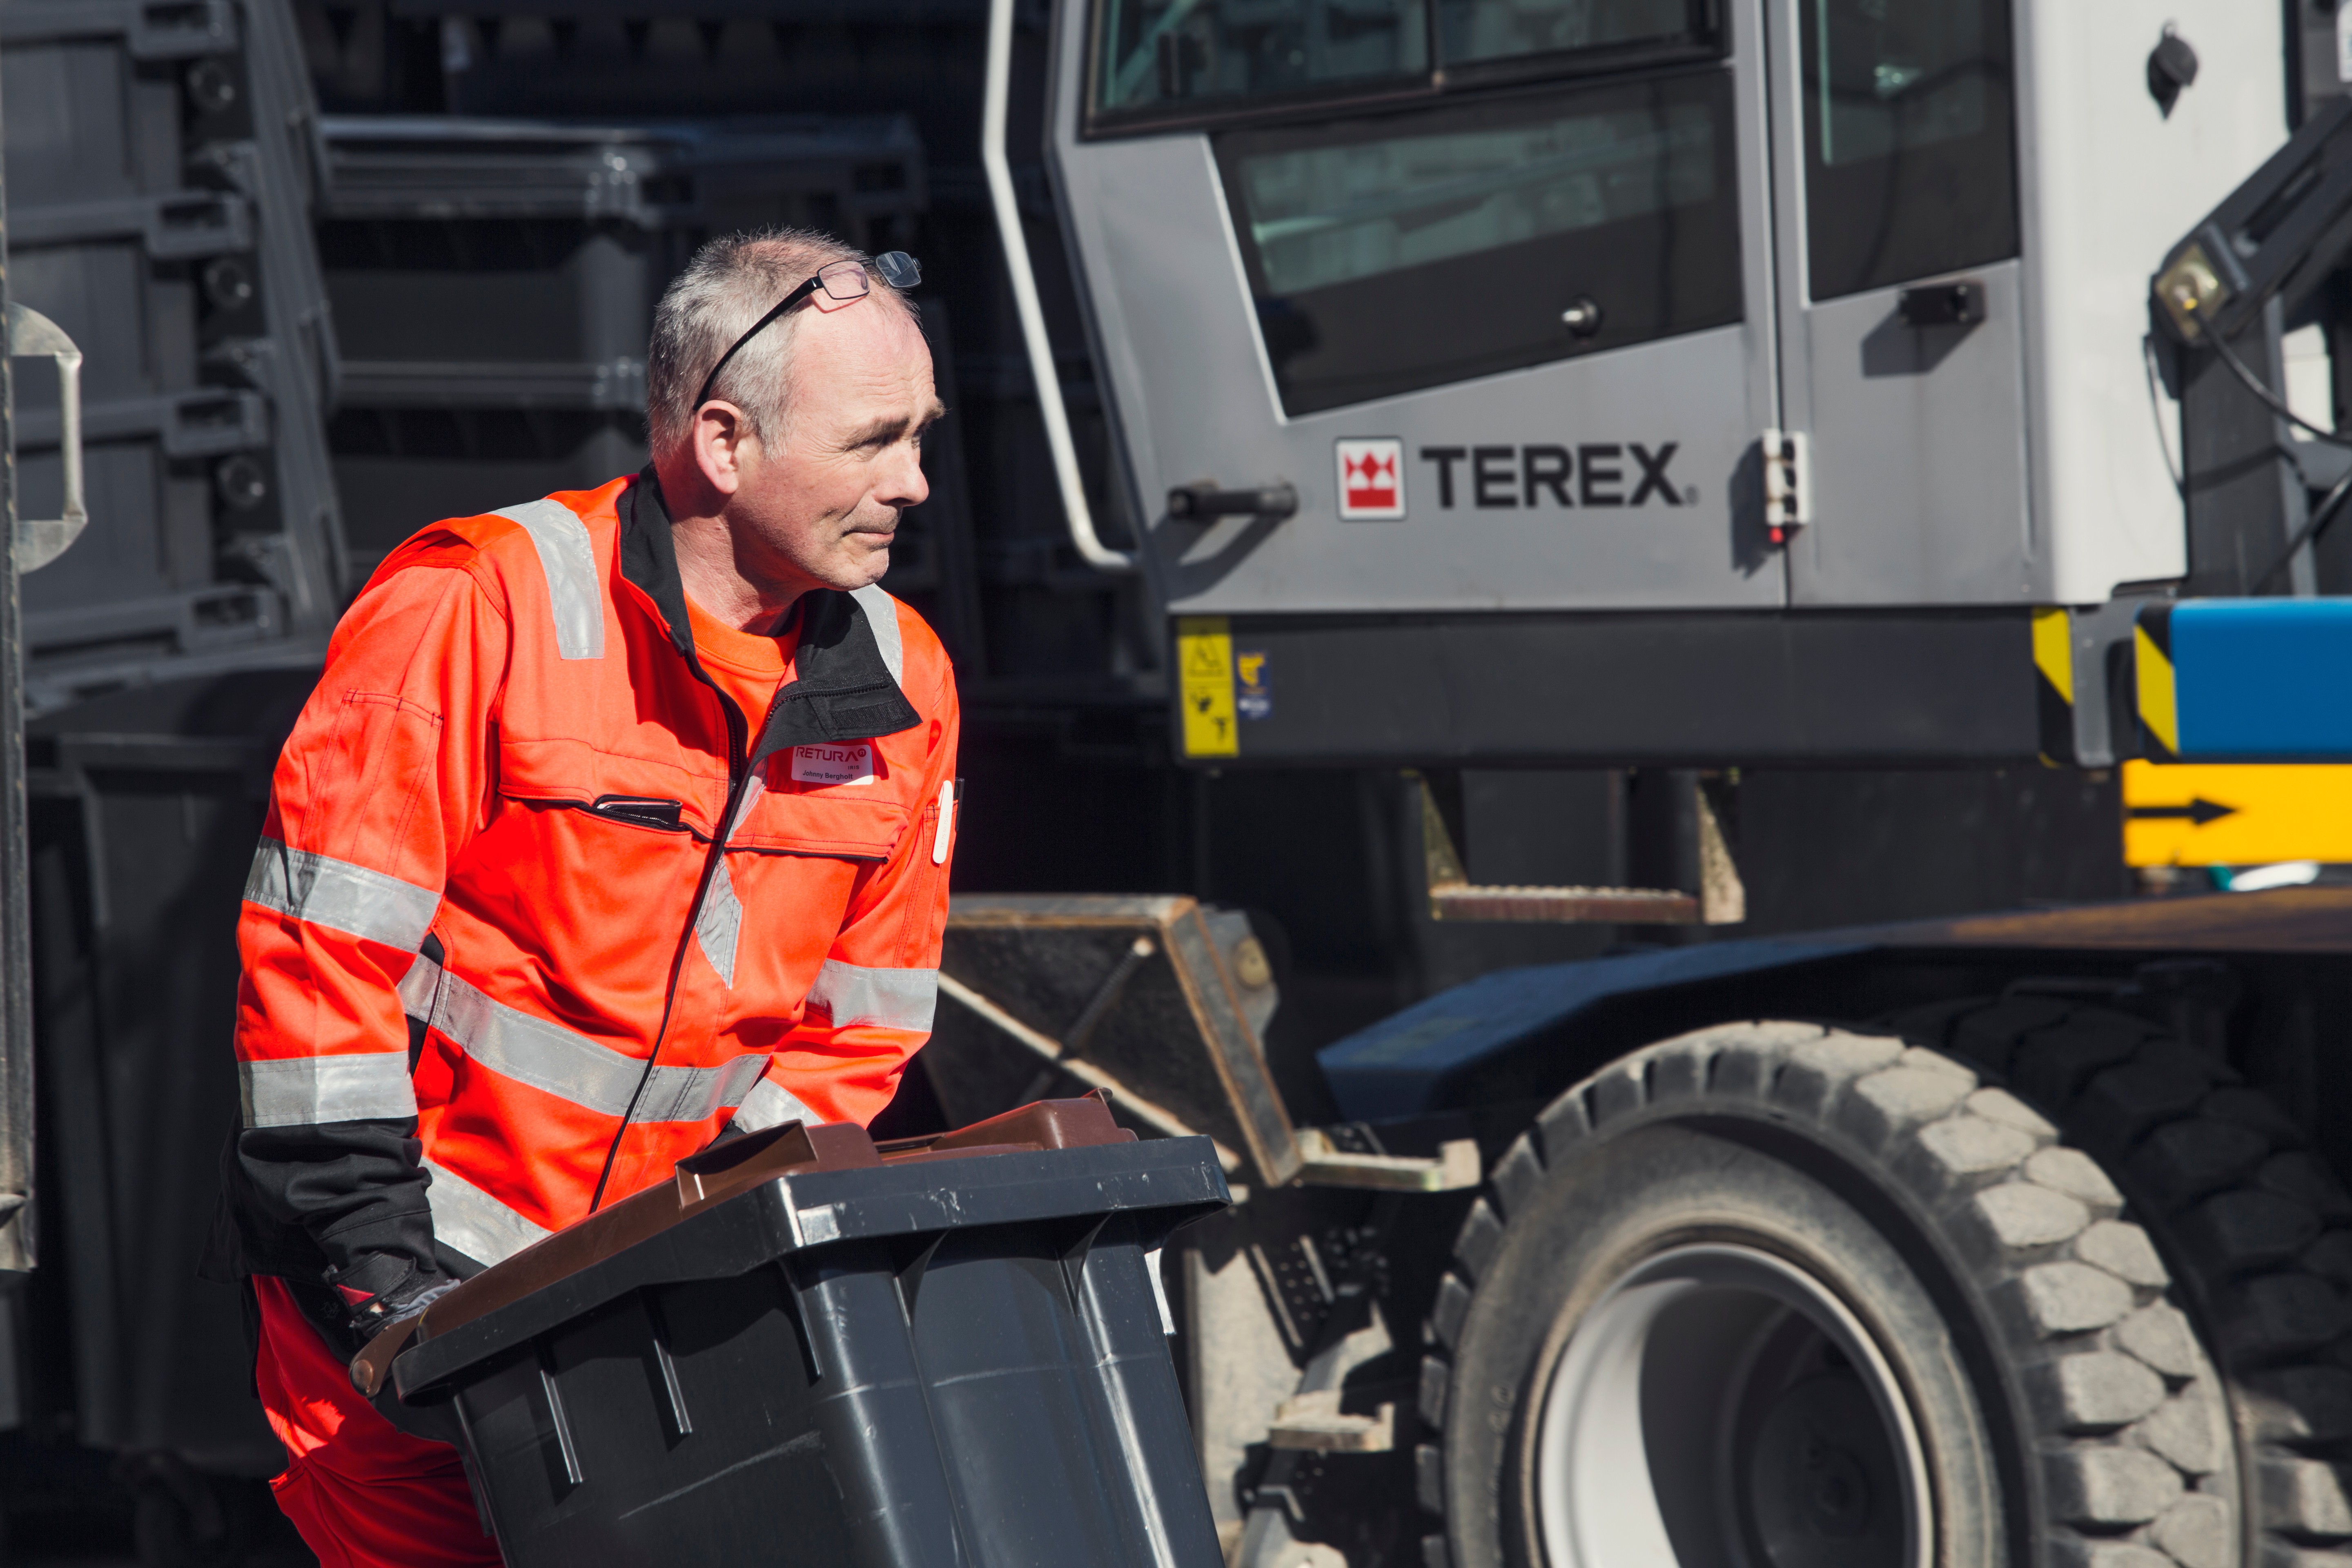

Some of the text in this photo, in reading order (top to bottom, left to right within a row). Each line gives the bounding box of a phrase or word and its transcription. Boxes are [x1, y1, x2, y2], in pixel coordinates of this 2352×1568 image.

[1419, 442, 1685, 509] TEREX
[796, 746, 859, 762] RETURA
[803, 770, 823, 779] Johnny
